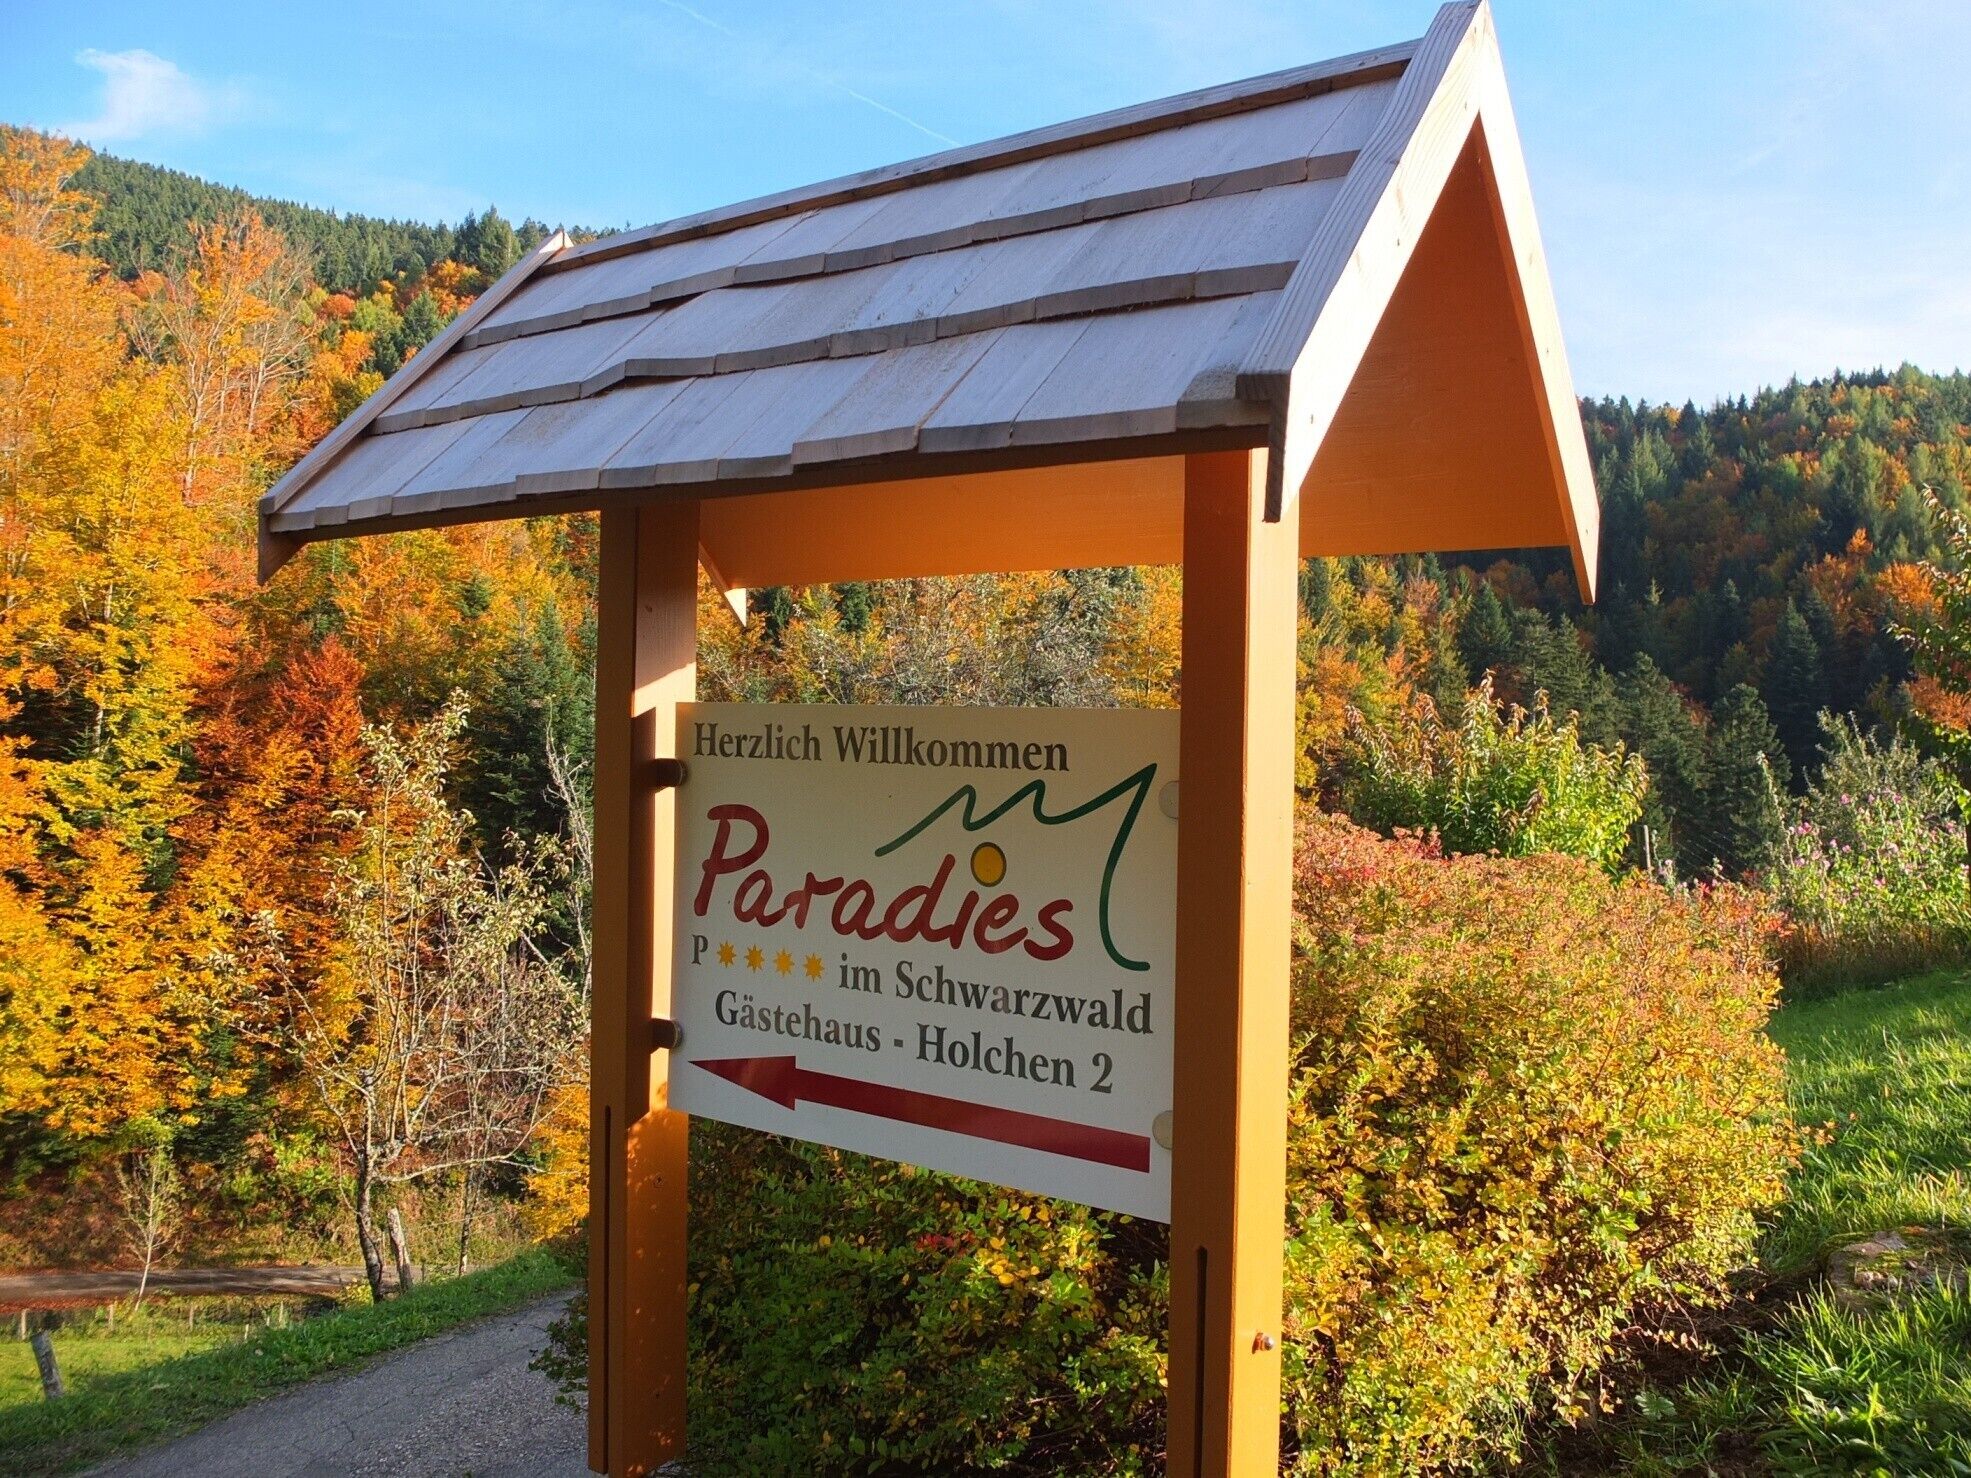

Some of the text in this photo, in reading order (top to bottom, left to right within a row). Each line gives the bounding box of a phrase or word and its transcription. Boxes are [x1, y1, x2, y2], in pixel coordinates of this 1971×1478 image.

[694, 722, 1069, 772] Herzlich Willkommen
[694, 804, 1074, 961] Paradies
[691, 934, 1154, 1034] P im Schwarzwald
[715, 990, 881, 1053] Gästehaus
[916, 1022, 1076, 1088] Holchen
[1089, 1052, 1114, 1094] 2
